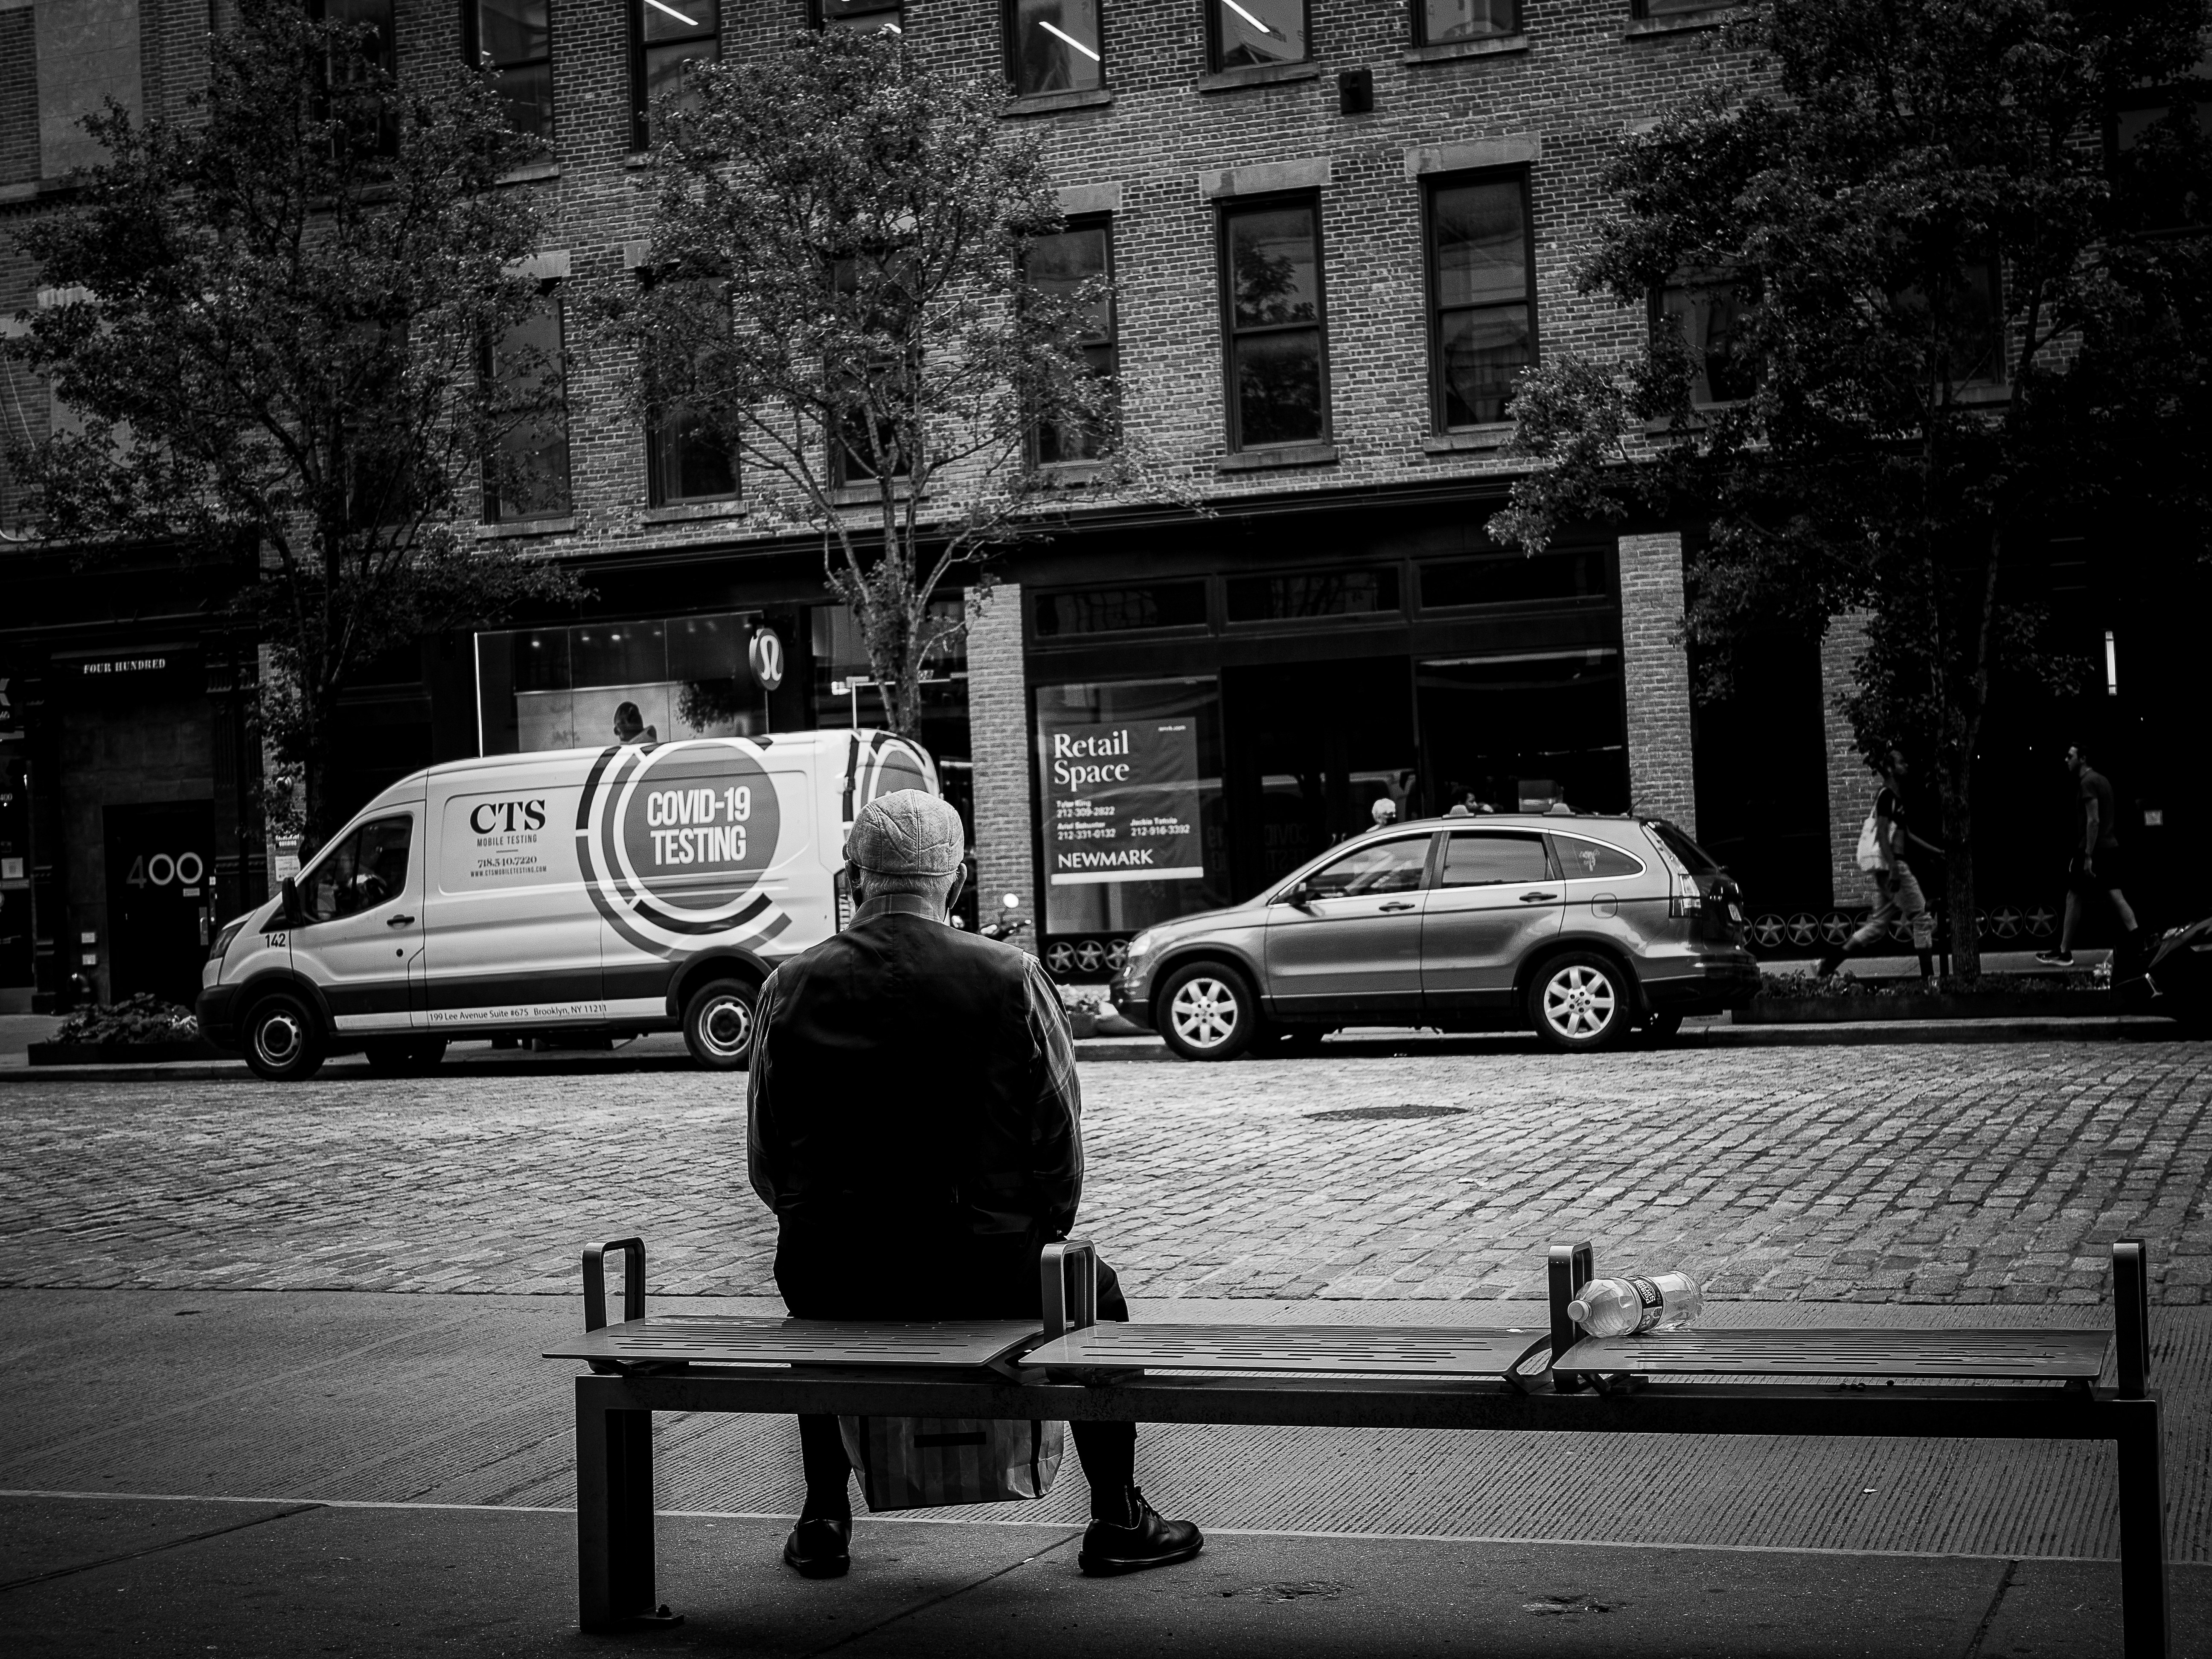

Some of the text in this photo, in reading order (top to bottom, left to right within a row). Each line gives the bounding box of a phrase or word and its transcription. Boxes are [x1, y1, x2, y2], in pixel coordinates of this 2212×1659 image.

[84, 658, 166, 674] FOUR HUNDRED
[1054, 729, 1129, 759] Retail
[1054, 759, 1130, 792] Space
[470, 799, 546, 835] CTS
[647, 786, 751, 827] COVID-19
[477, 834, 537, 847] MOBILE TESTING
[650, 825, 747, 865] TESTING
[126, 852, 203, 889] 400
[477, 856, 537, 868] 718.510.7220
[1058, 849, 1154, 868] NEWMARK
[265, 933, 286, 948] 142
[430, 1004, 606, 1021] 199 Lee Avenue Suite #675 Brooklyn, NY 11211
